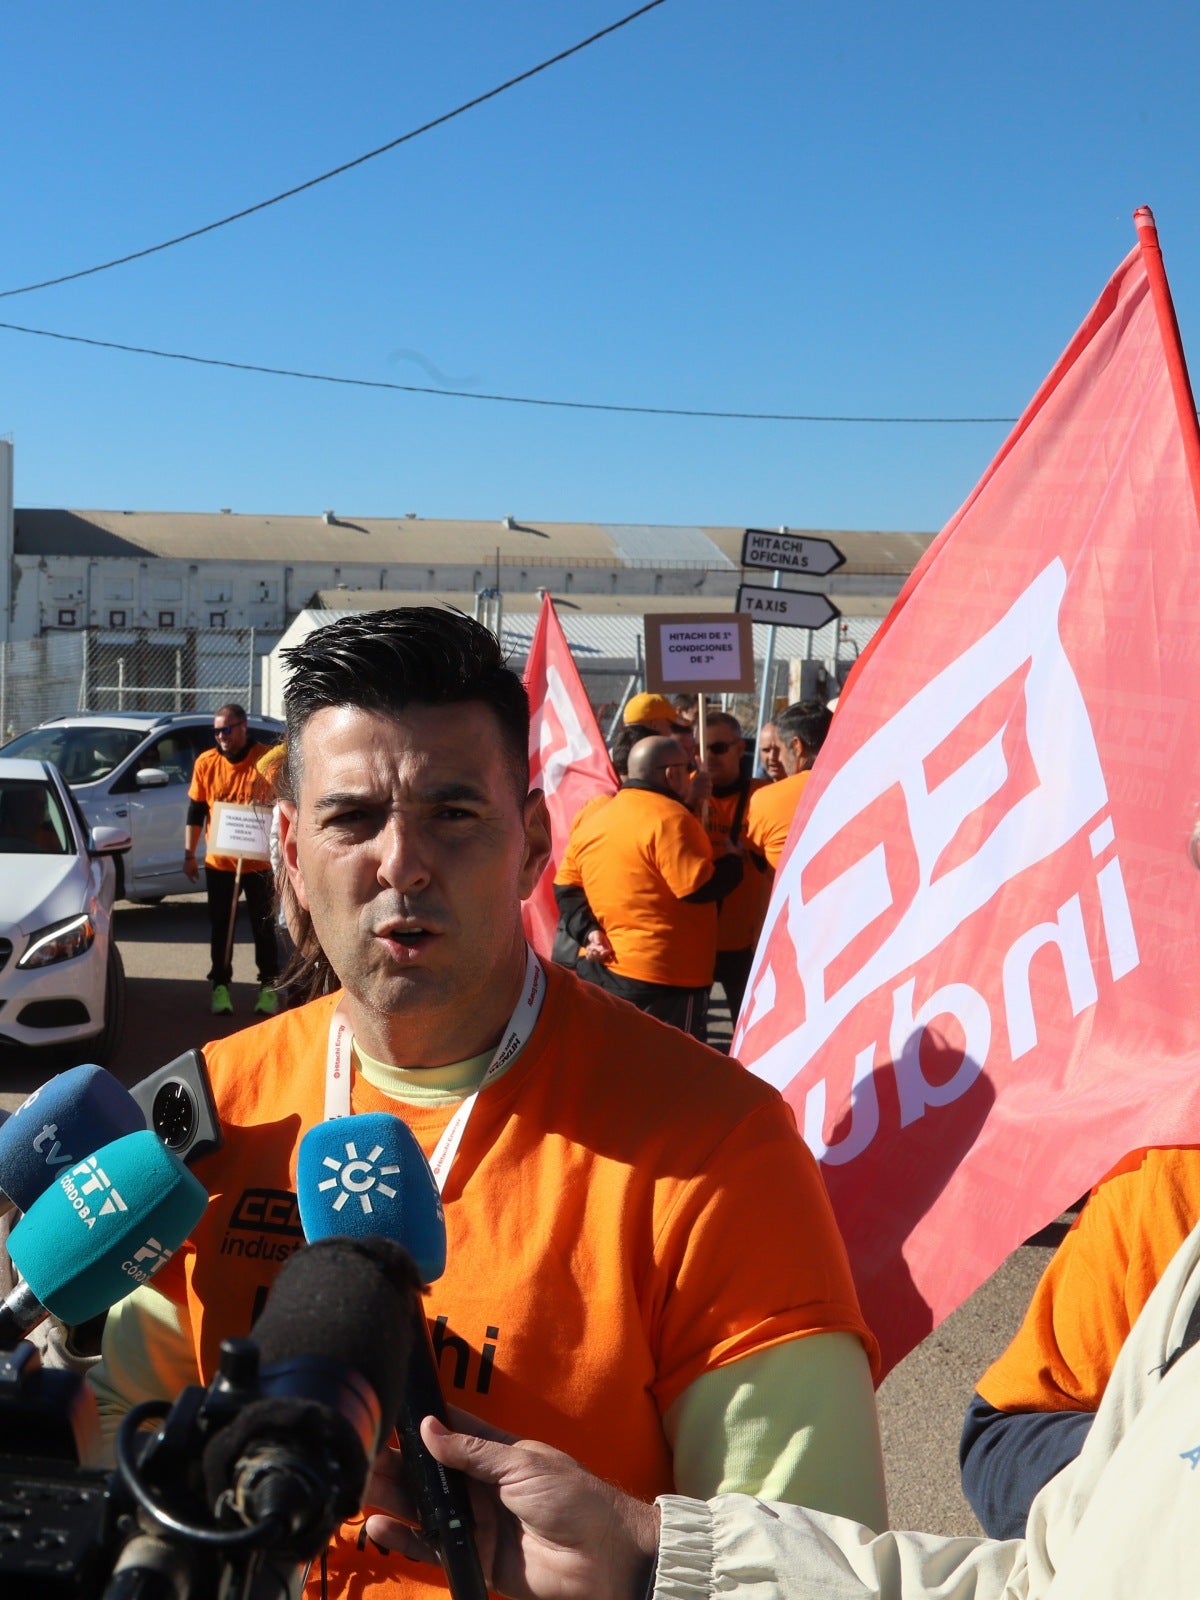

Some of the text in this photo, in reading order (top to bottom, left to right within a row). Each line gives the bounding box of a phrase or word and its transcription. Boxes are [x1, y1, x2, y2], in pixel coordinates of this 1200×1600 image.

[752, 537, 803, 553] HITACHI
[750, 550, 809, 567] OFICINAS
[746, 598, 788, 613] TAXIS
[669, 632, 708, 641] HITACHI
[709, 631, 721, 640] DE
[668, 643, 734, 653] CONDICIONES
[690, 655, 703, 664] DE
[335, 1025, 346, 1047] Energy
[60, 1175, 97, 1230] CÓRDOBA
